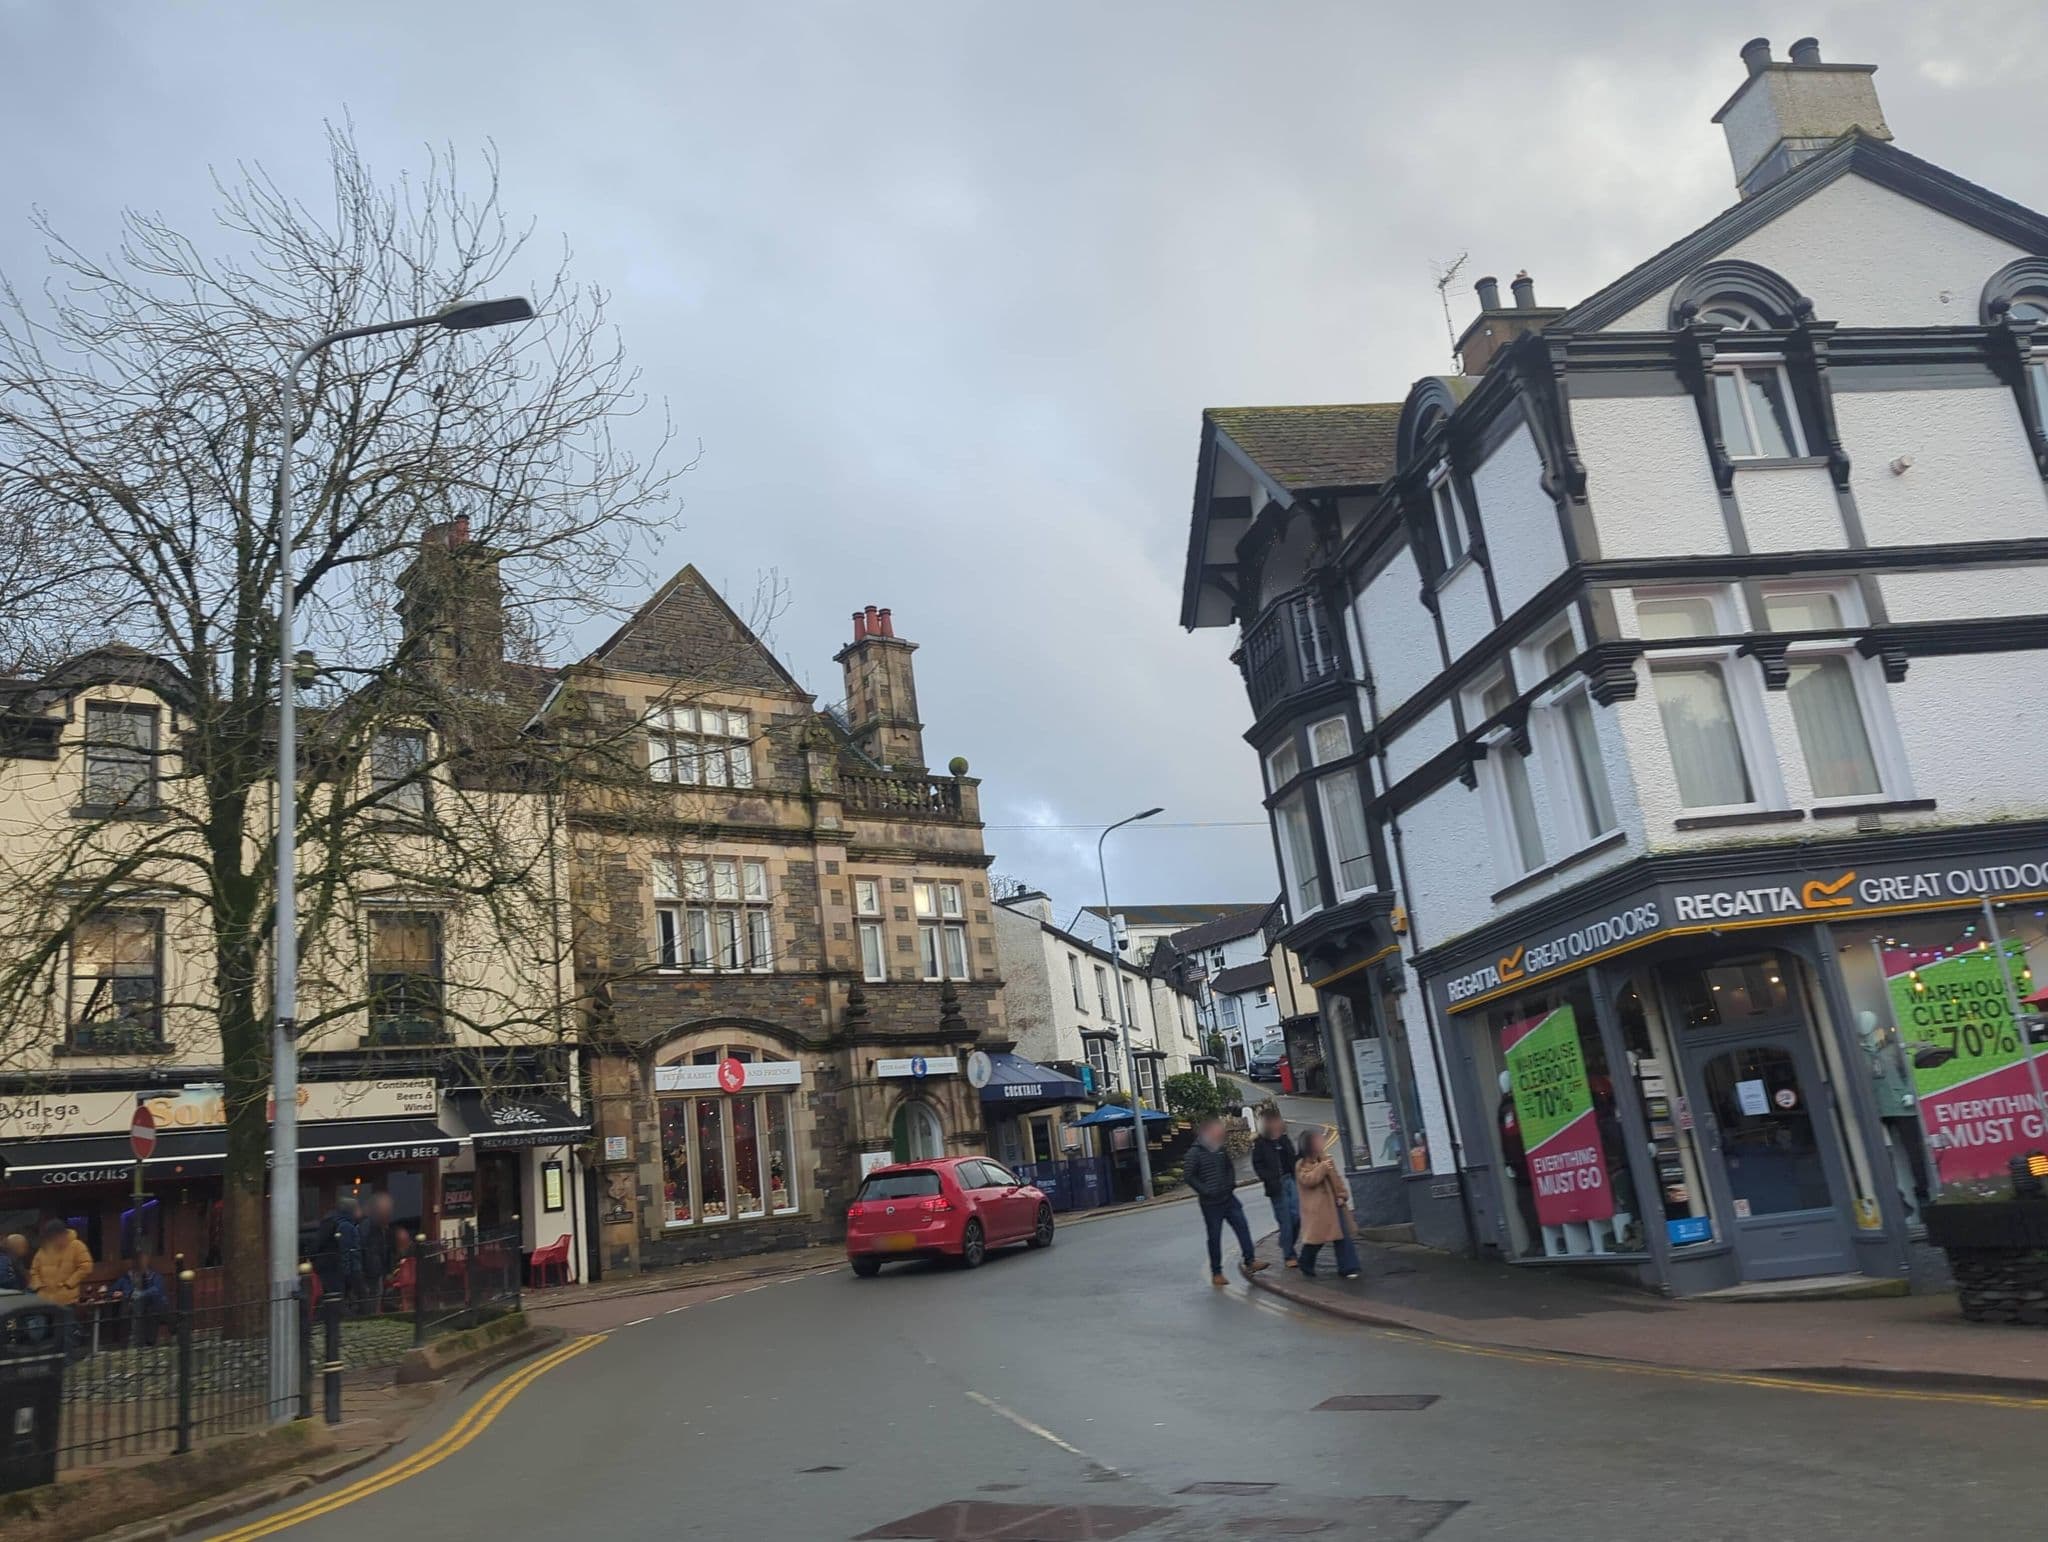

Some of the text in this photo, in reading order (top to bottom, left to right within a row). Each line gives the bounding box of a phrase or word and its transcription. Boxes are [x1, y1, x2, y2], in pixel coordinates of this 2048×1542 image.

[1674, 886, 1802, 922] REGATTA
[1859, 872, 1941, 904] GREAT
[1447, 965, 1502, 1002] REGATTA
[1524, 936, 1572, 973] GREAT
[1567, 902, 1660, 957] OUTDOORS
[1905, 975, 2027, 1005] WAREHOUE
[1942, 1020, 2016, 1060] 70%
[1517, 1041, 1576, 1072] WAREHOUSE
[1003, 1084, 1042, 1097] COCKTAILS
[1520, 1059, 1578, 1091] CLEAROUT
[396, 1092, 423, 1101] Beers
[403, 1103, 433, 1112] Wines
[1534, 1086, 1574, 1119] 70%
[1939, 1117, 2014, 1150] MUST
[368, 1147, 440, 1161] CRAFT BEER
[1533, 1146, 1598, 1175] EVERYTHING
[41, 1168, 129, 1184] COCKTAILS
[1536, 1166, 1602, 1197] MUST GO
